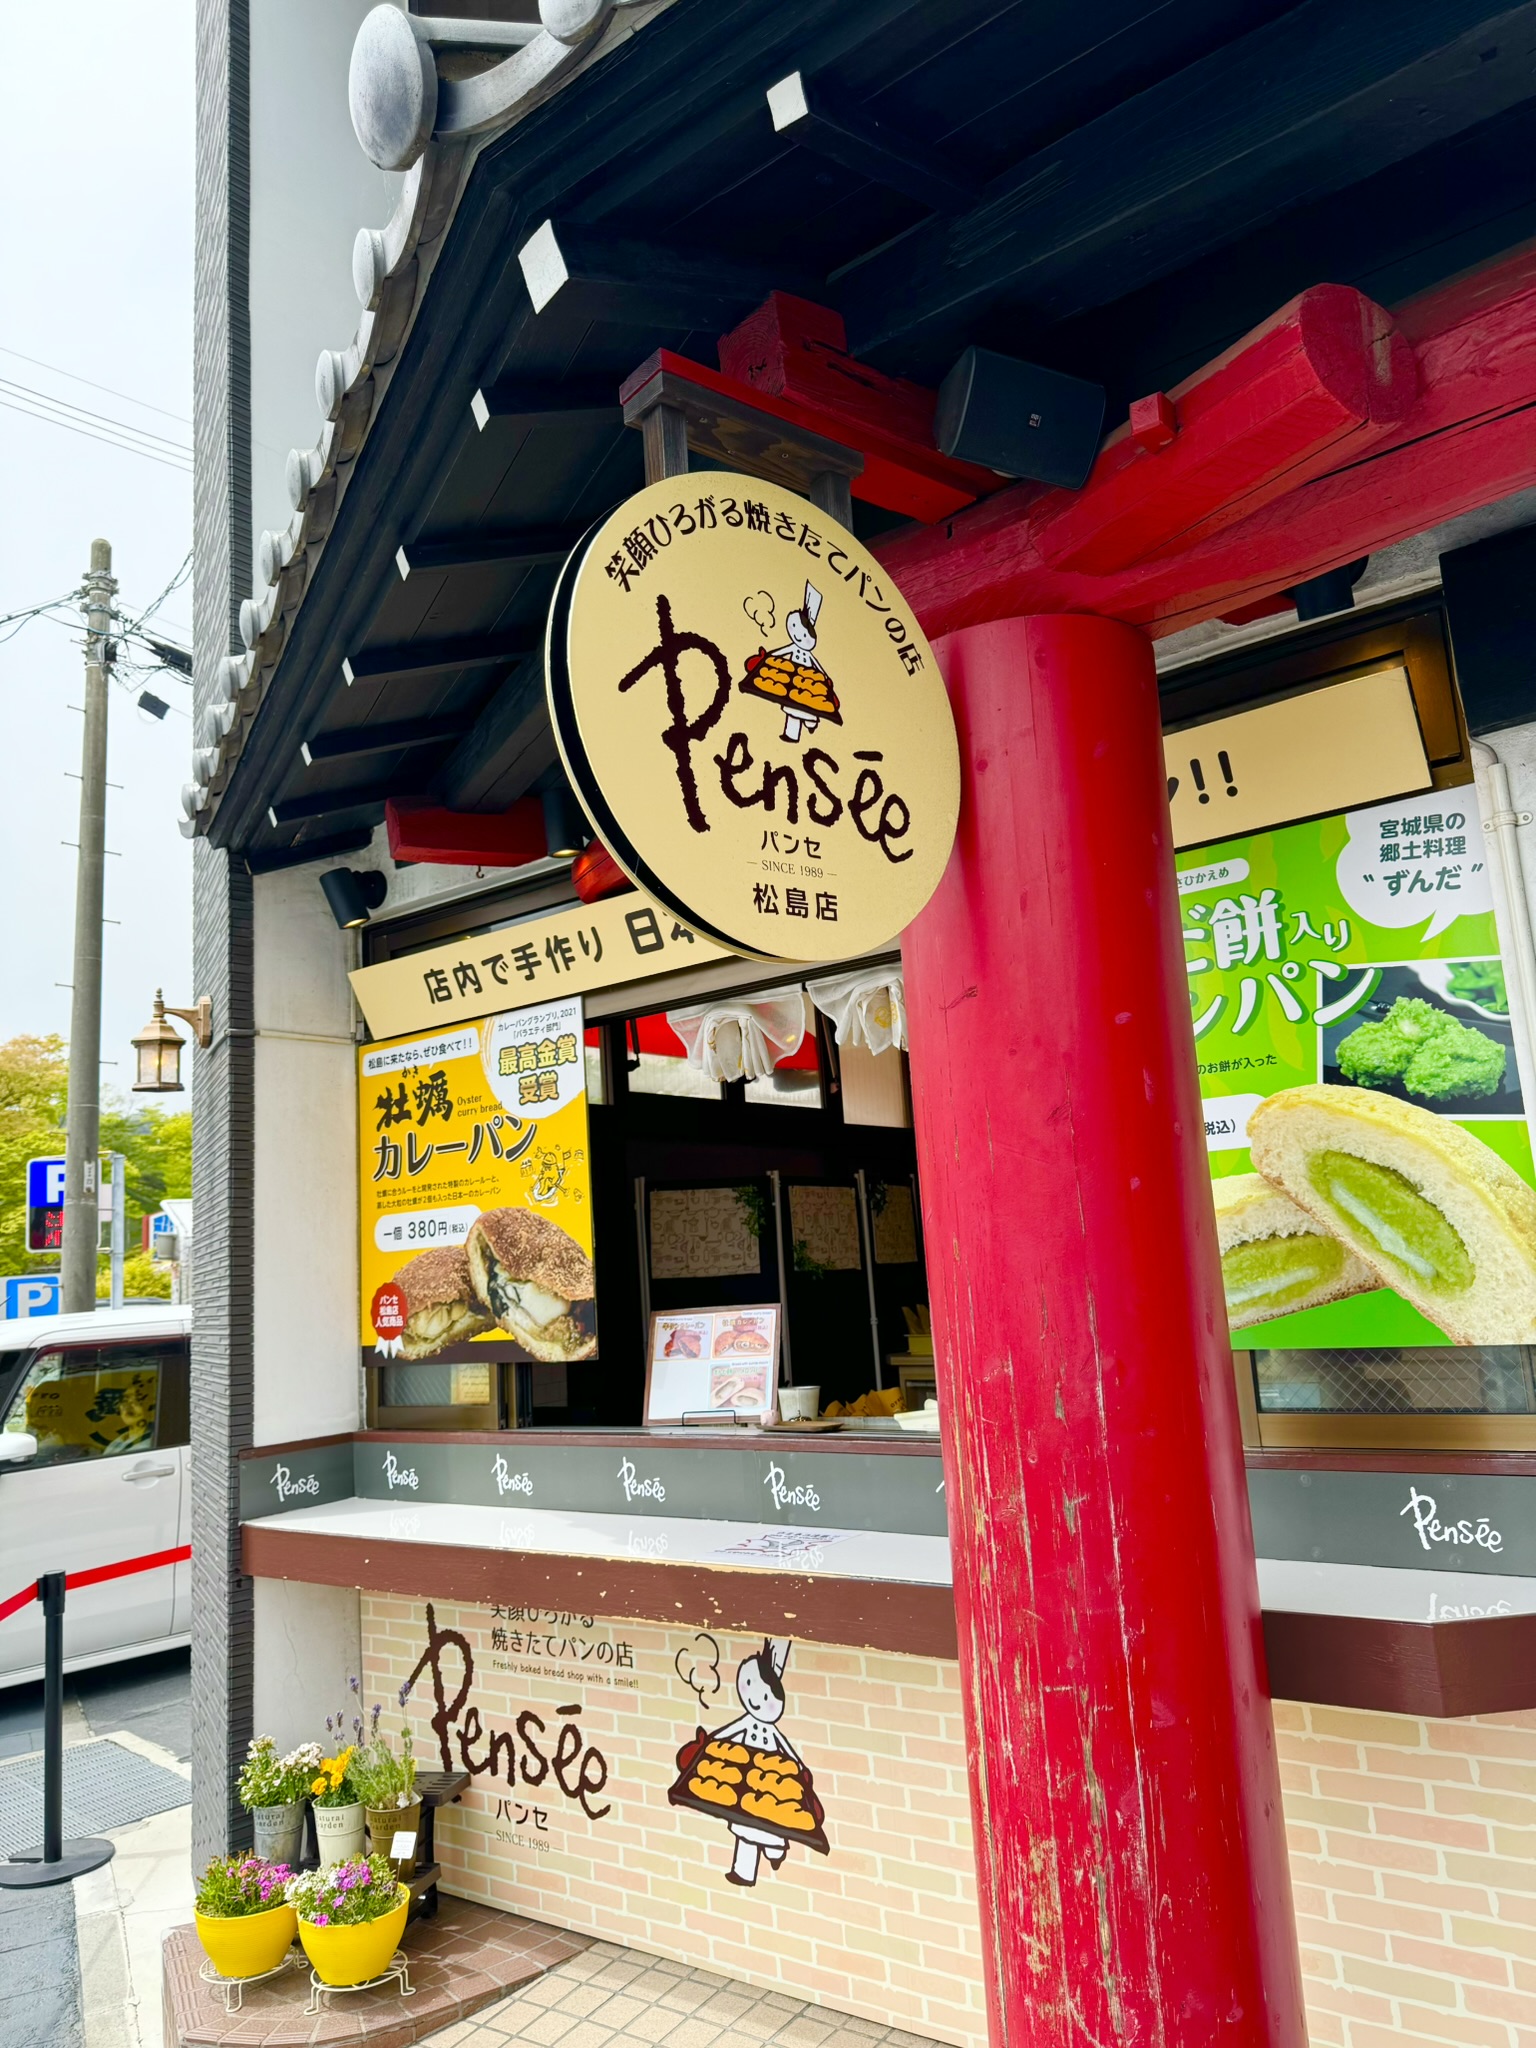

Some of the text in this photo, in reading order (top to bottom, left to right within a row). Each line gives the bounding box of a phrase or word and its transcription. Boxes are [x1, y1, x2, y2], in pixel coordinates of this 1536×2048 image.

[604, 496, 925, 677] 笑顔ひろがる焼きたてパンの店
[1380, 812, 1466, 839] 宮城県の
[761, 830, 821, 859] パンセ
[1379, 835, 1467, 863] 郷土料理
[761, 860, 824, 878] SINCE 1989
[753, 882, 838, 921] 松島店
[423, 926, 604, 1004] 店内で手作り
[499, 1033, 578, 1076] 最高金賞
[373, 1070, 454, 1132] 牡蠣
[457, 1095, 482, 1106] Oyster
[518, 1070, 559, 1105] 受賞
[457, 1101, 503, 1117] curry bread
[372, 1114, 538, 1182] カレーパン
[383, 1226, 403, 1241] 一個
[379, 1295, 399, 1305] パンセ
[491, 1627, 634, 1669] 焼きたてパンの店
[492, 1659, 518, 1673] Freshly
[520, 1663, 541, 1675] baked
[544, 1666, 565, 1678] bread
[567, 1671, 584, 1683] shop
[587, 1673, 603, 1684] with
[496, 1799, 548, 1831] パンセ
[496, 1829, 550, 1853] SINCE 1989
